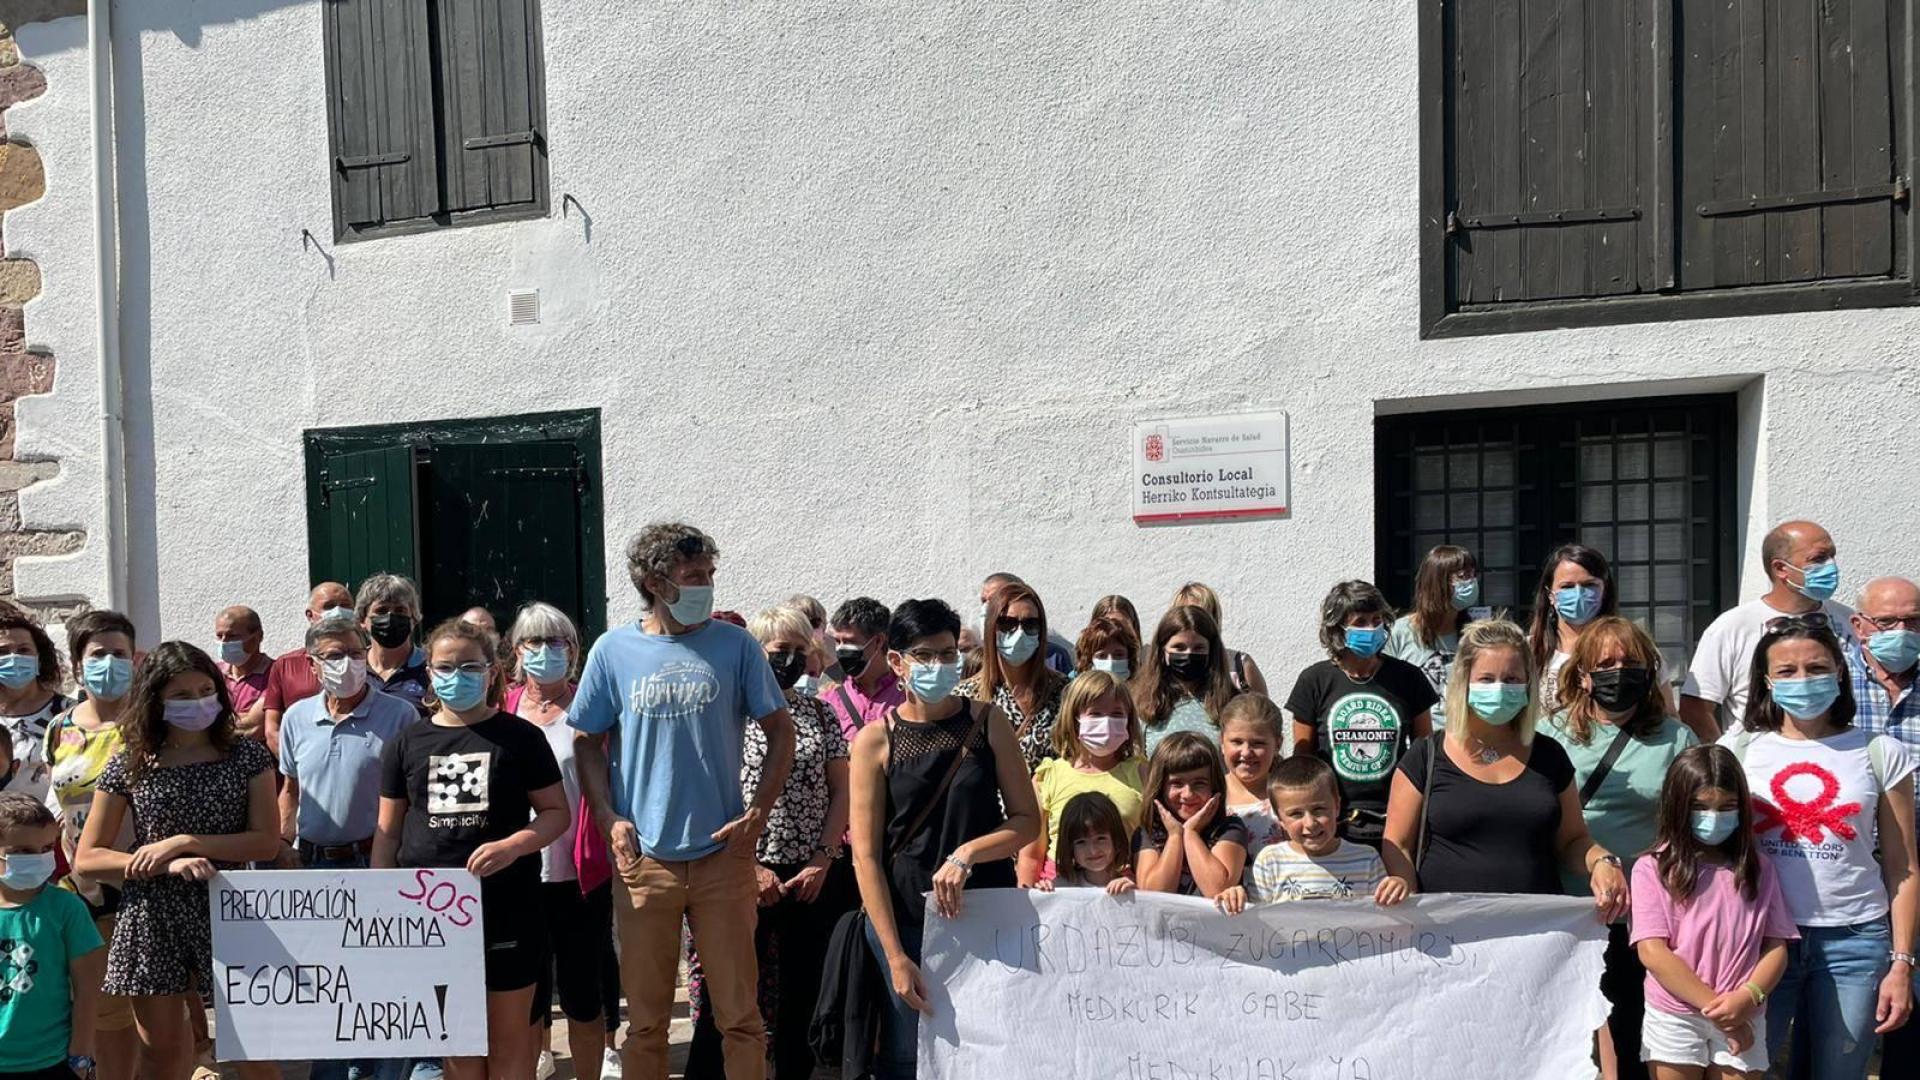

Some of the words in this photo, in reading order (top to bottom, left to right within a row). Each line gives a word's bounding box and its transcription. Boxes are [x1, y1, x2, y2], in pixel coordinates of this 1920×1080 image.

[1231, 433, 1240, 442] de
[1242, 432, 1261, 441] Salud
[1142, 469, 1213, 487] Consultorio
[1219, 466, 1253, 482] Local
[1142, 487, 1187, 505] Herriko
[1191, 482, 1276, 503] Kontsultategia
[1337, 701, 1364, 722] BOARD
[1335, 731, 1395, 741] CHAMONIX
[1761, 840, 1799, 849] UNITED
[1767, 847, 1778, 855] OF
[1781, 849, 1839, 860] BENETTON
[220, 878, 357, 921] PREOCUPACIÓN
[341, 908, 446, 948] MÁXIMA
[226, 964, 353, 1006] EGOERA
[1241, 990, 1325, 1021] GABE
